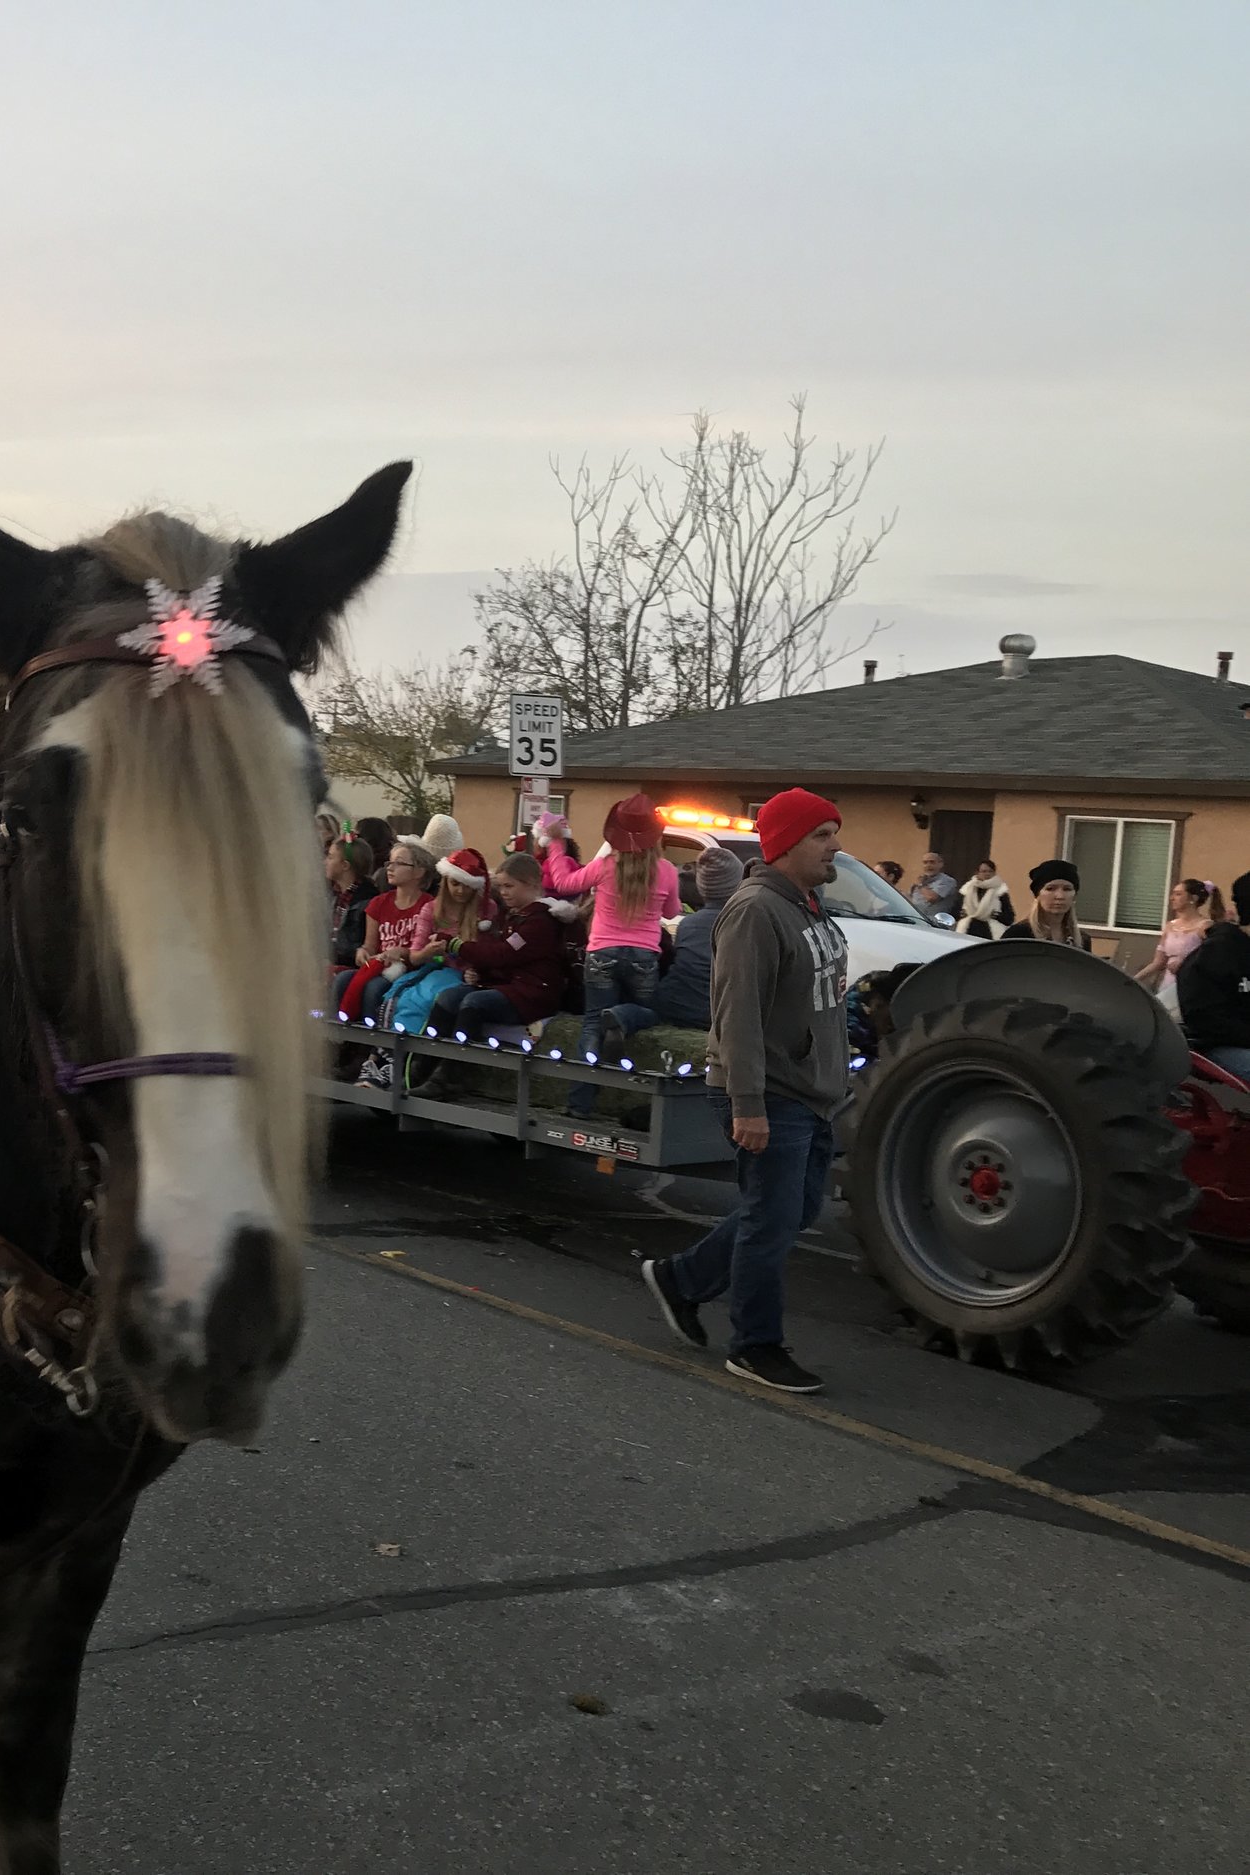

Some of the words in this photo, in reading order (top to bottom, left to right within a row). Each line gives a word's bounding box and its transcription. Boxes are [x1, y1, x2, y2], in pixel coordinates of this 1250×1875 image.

[514, 703, 559, 718] SPEED
[518, 720, 554, 733] LIMIT
[516, 736, 558, 767] 35
[813, 964, 837, 1011] IT
